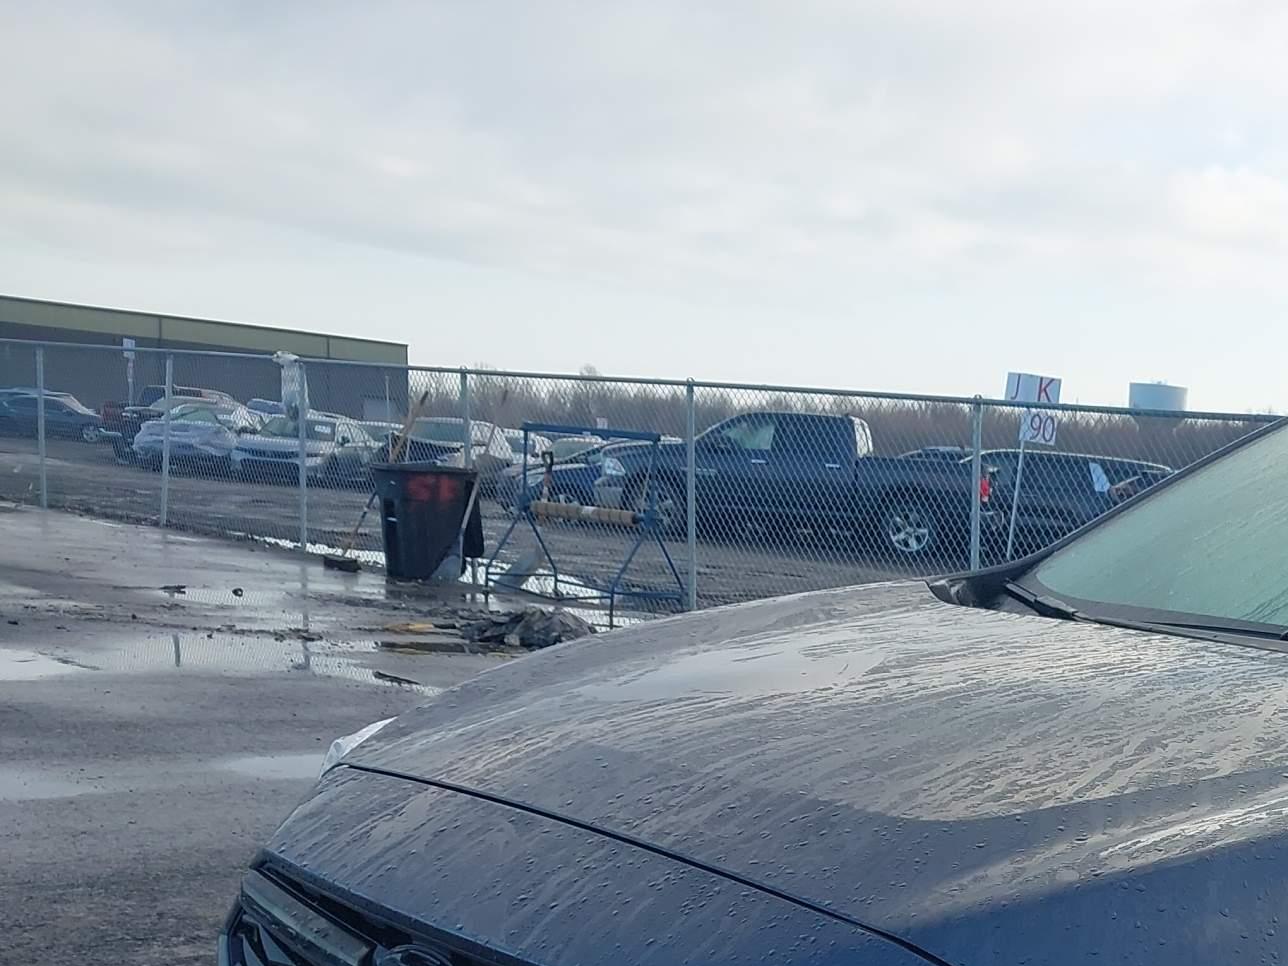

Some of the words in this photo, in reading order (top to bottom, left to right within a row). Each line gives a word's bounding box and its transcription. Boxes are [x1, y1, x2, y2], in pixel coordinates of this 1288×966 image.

[1010, 374, 1021, 400] J
[1037, 376, 1056, 403] K
[1029, 413, 1055, 442] 90
